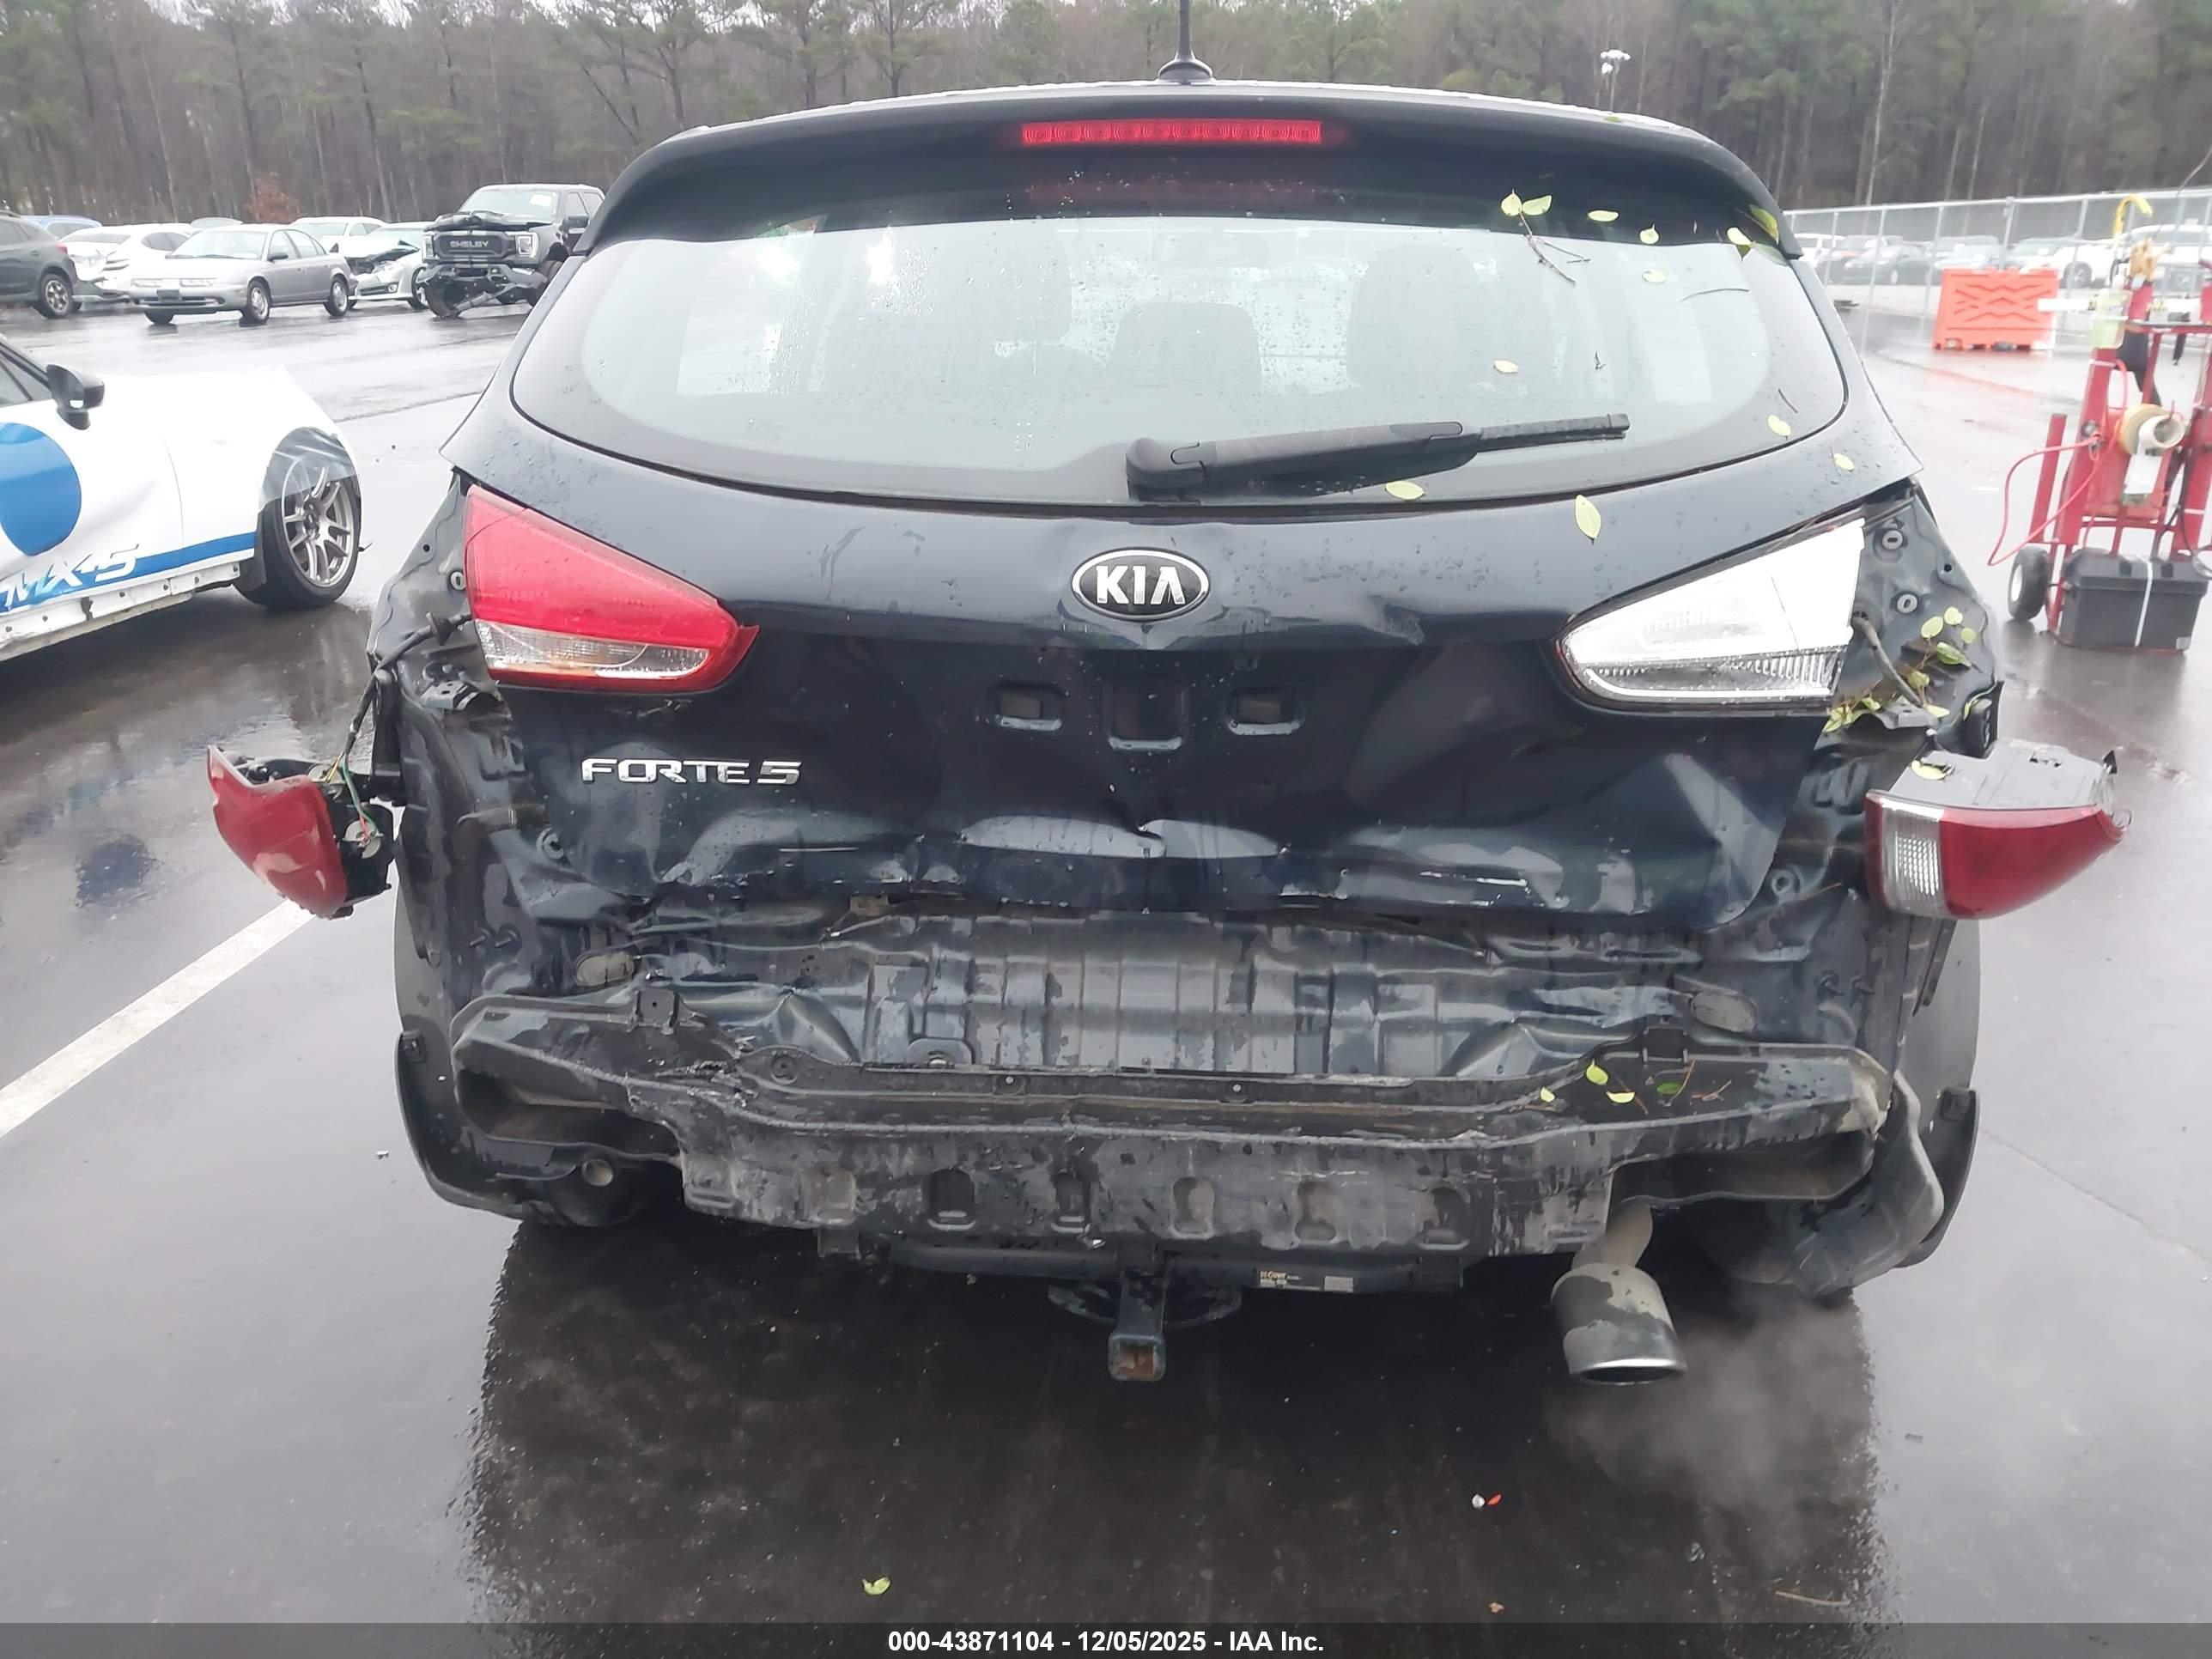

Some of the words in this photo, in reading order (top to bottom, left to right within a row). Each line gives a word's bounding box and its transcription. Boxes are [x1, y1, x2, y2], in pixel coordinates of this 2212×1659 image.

[1096, 565, 1186, 605] KIA
[581, 758, 750, 783] FORTE
[757, 761, 802, 785] 5
